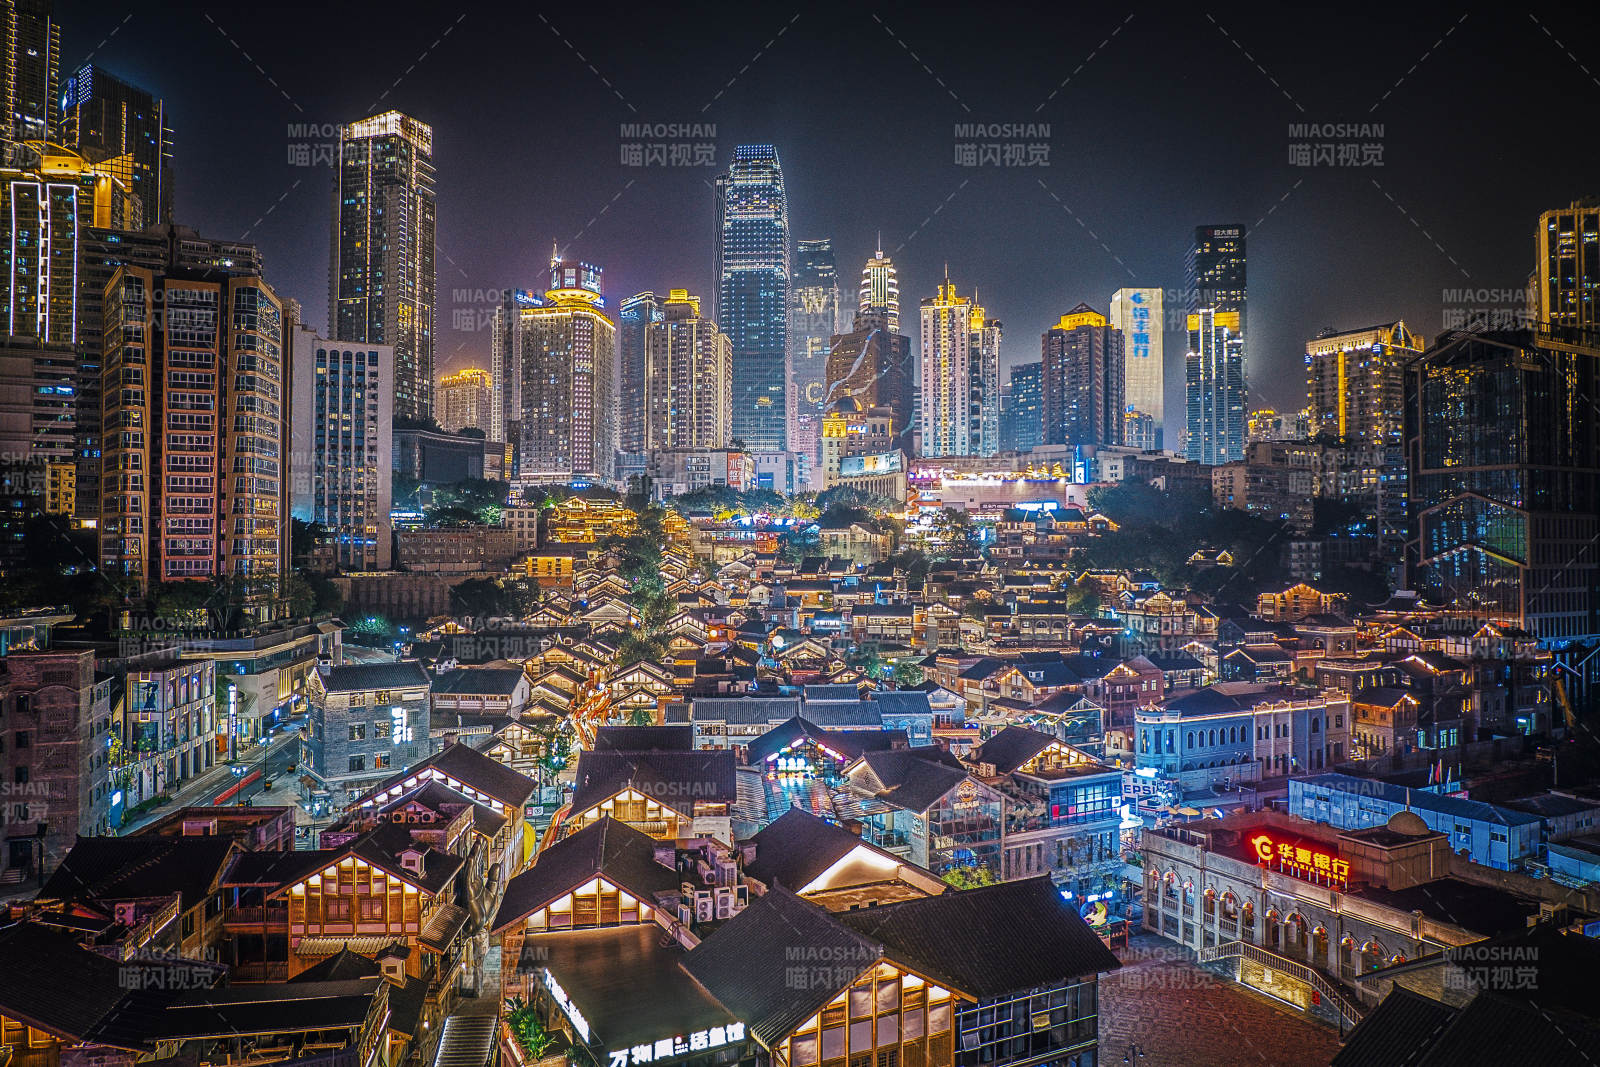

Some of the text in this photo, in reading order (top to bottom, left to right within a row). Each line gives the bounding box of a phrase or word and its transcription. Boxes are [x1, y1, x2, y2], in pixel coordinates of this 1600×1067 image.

[1277, 842, 1350, 876] 华夏银行
[1281, 858, 1346, 882] HUAXIA BANK
